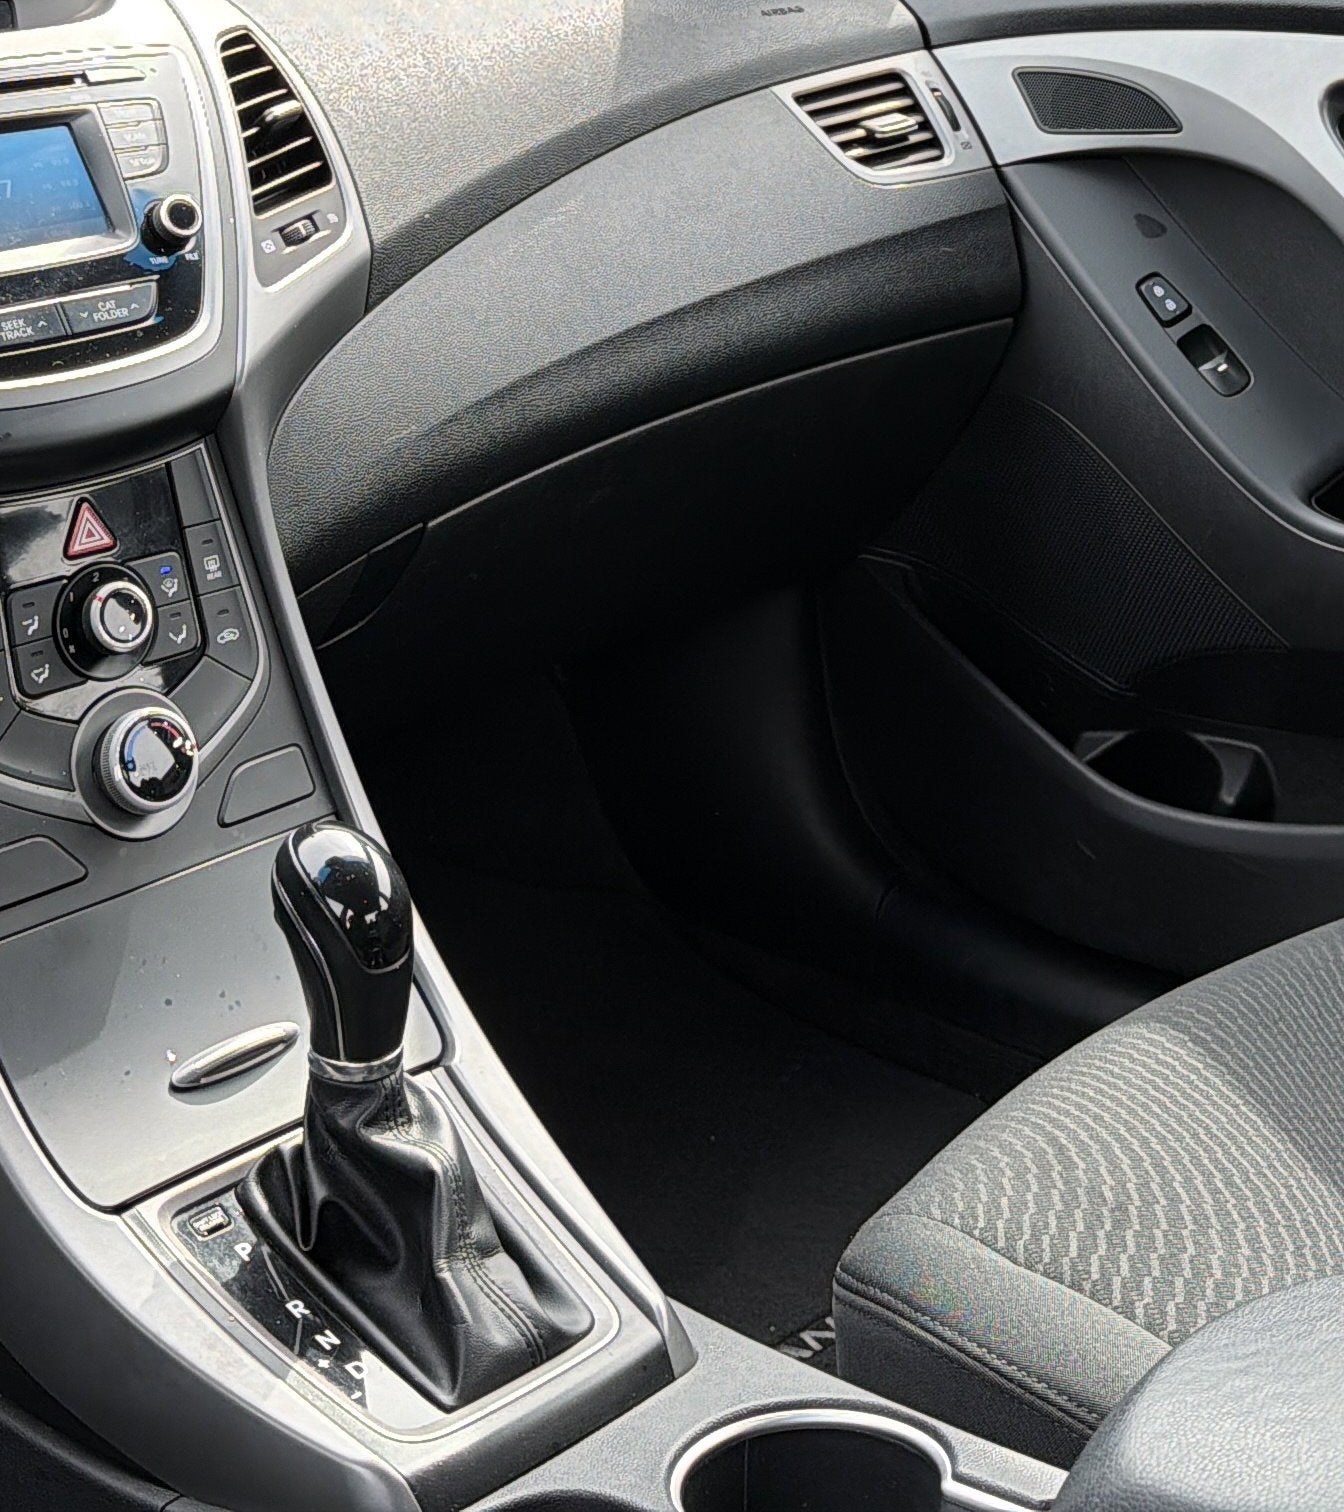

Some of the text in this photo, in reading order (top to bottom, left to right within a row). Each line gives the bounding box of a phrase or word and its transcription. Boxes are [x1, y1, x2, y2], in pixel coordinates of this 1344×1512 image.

[97, 300, 117, 312] CAT
[93, 308, 130, 322] FOLDER
[1, 318, 26, 332] SEEK
[1, 325, 35, 342] TRACK
[92, 573, 100, 583] 2
[234, 1242, 253, 1262] P
[285, 1299, 311, 1319] R
[314, 1329, 341, 1350] N
[344, 1360, 368, 1380] D
